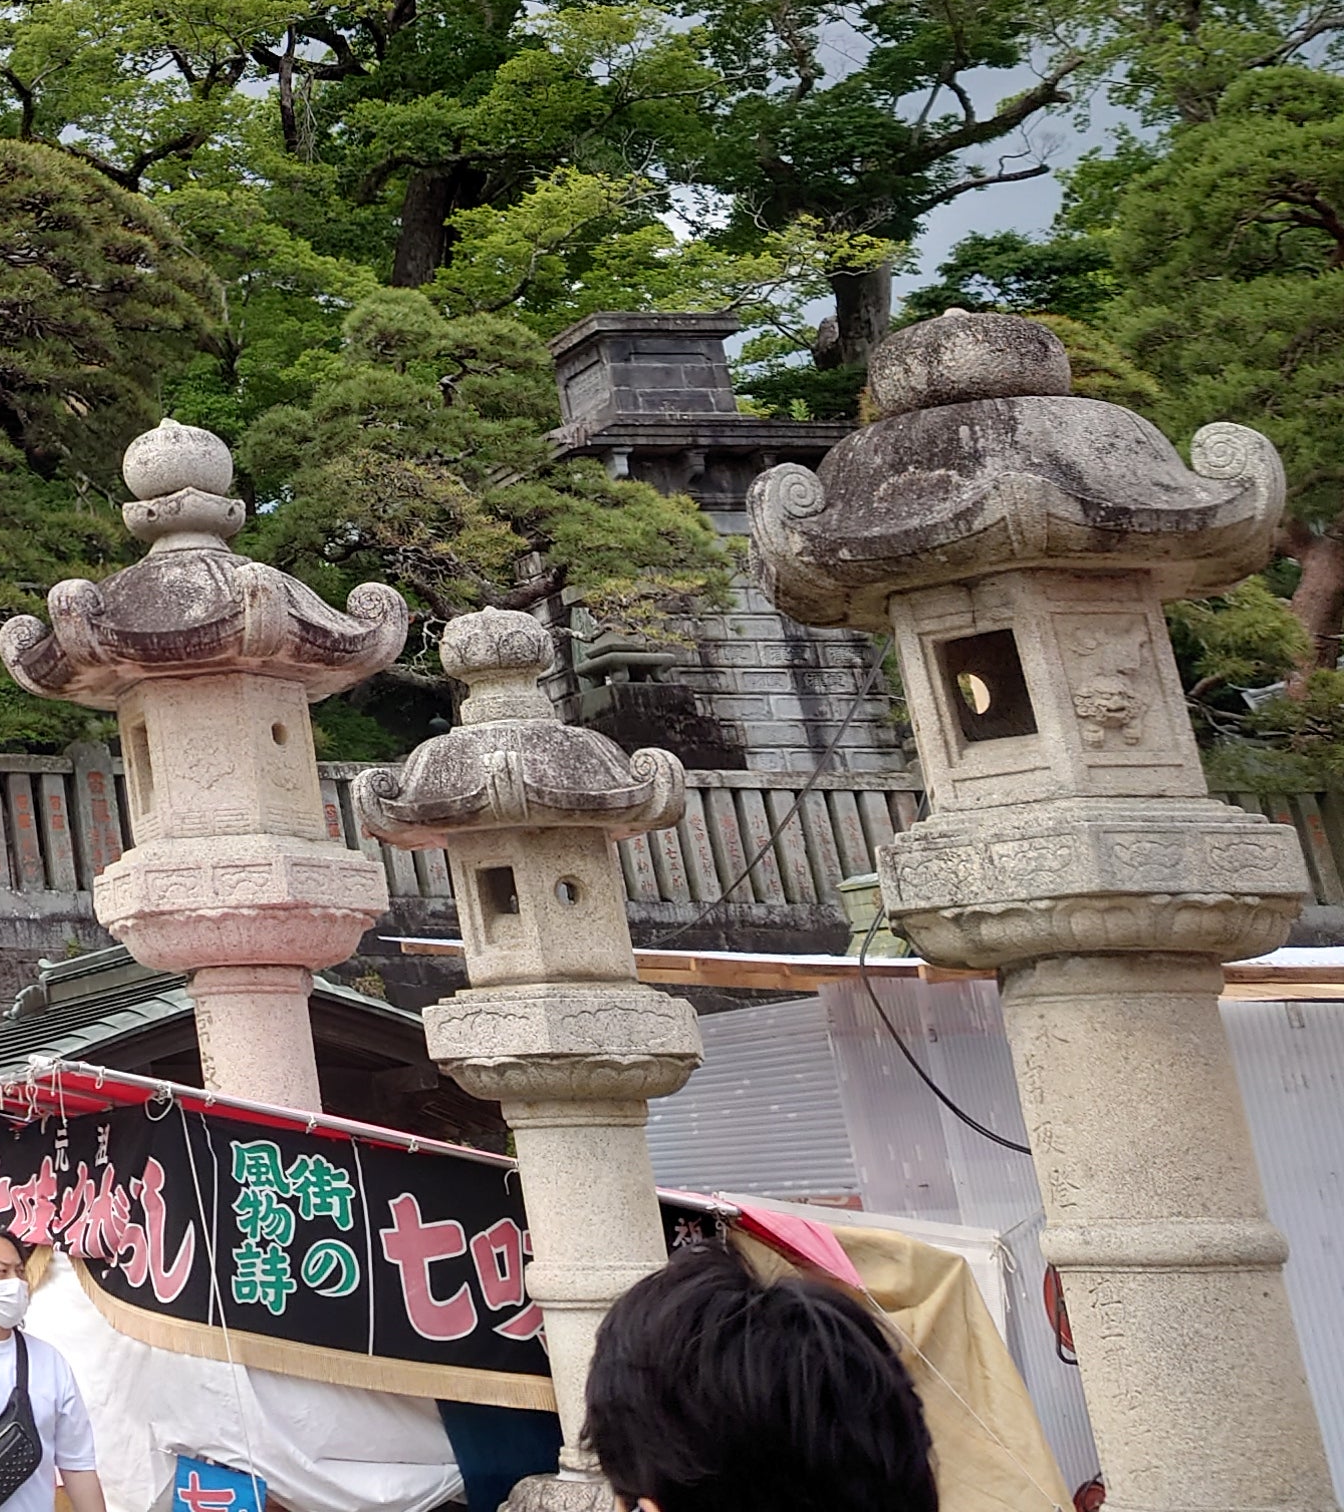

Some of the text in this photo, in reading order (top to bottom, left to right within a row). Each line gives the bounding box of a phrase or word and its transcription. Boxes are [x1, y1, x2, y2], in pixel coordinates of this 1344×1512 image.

[230, 1140, 297, 1316] 風物詩
[287, 1154, 360, 1297] 街の
